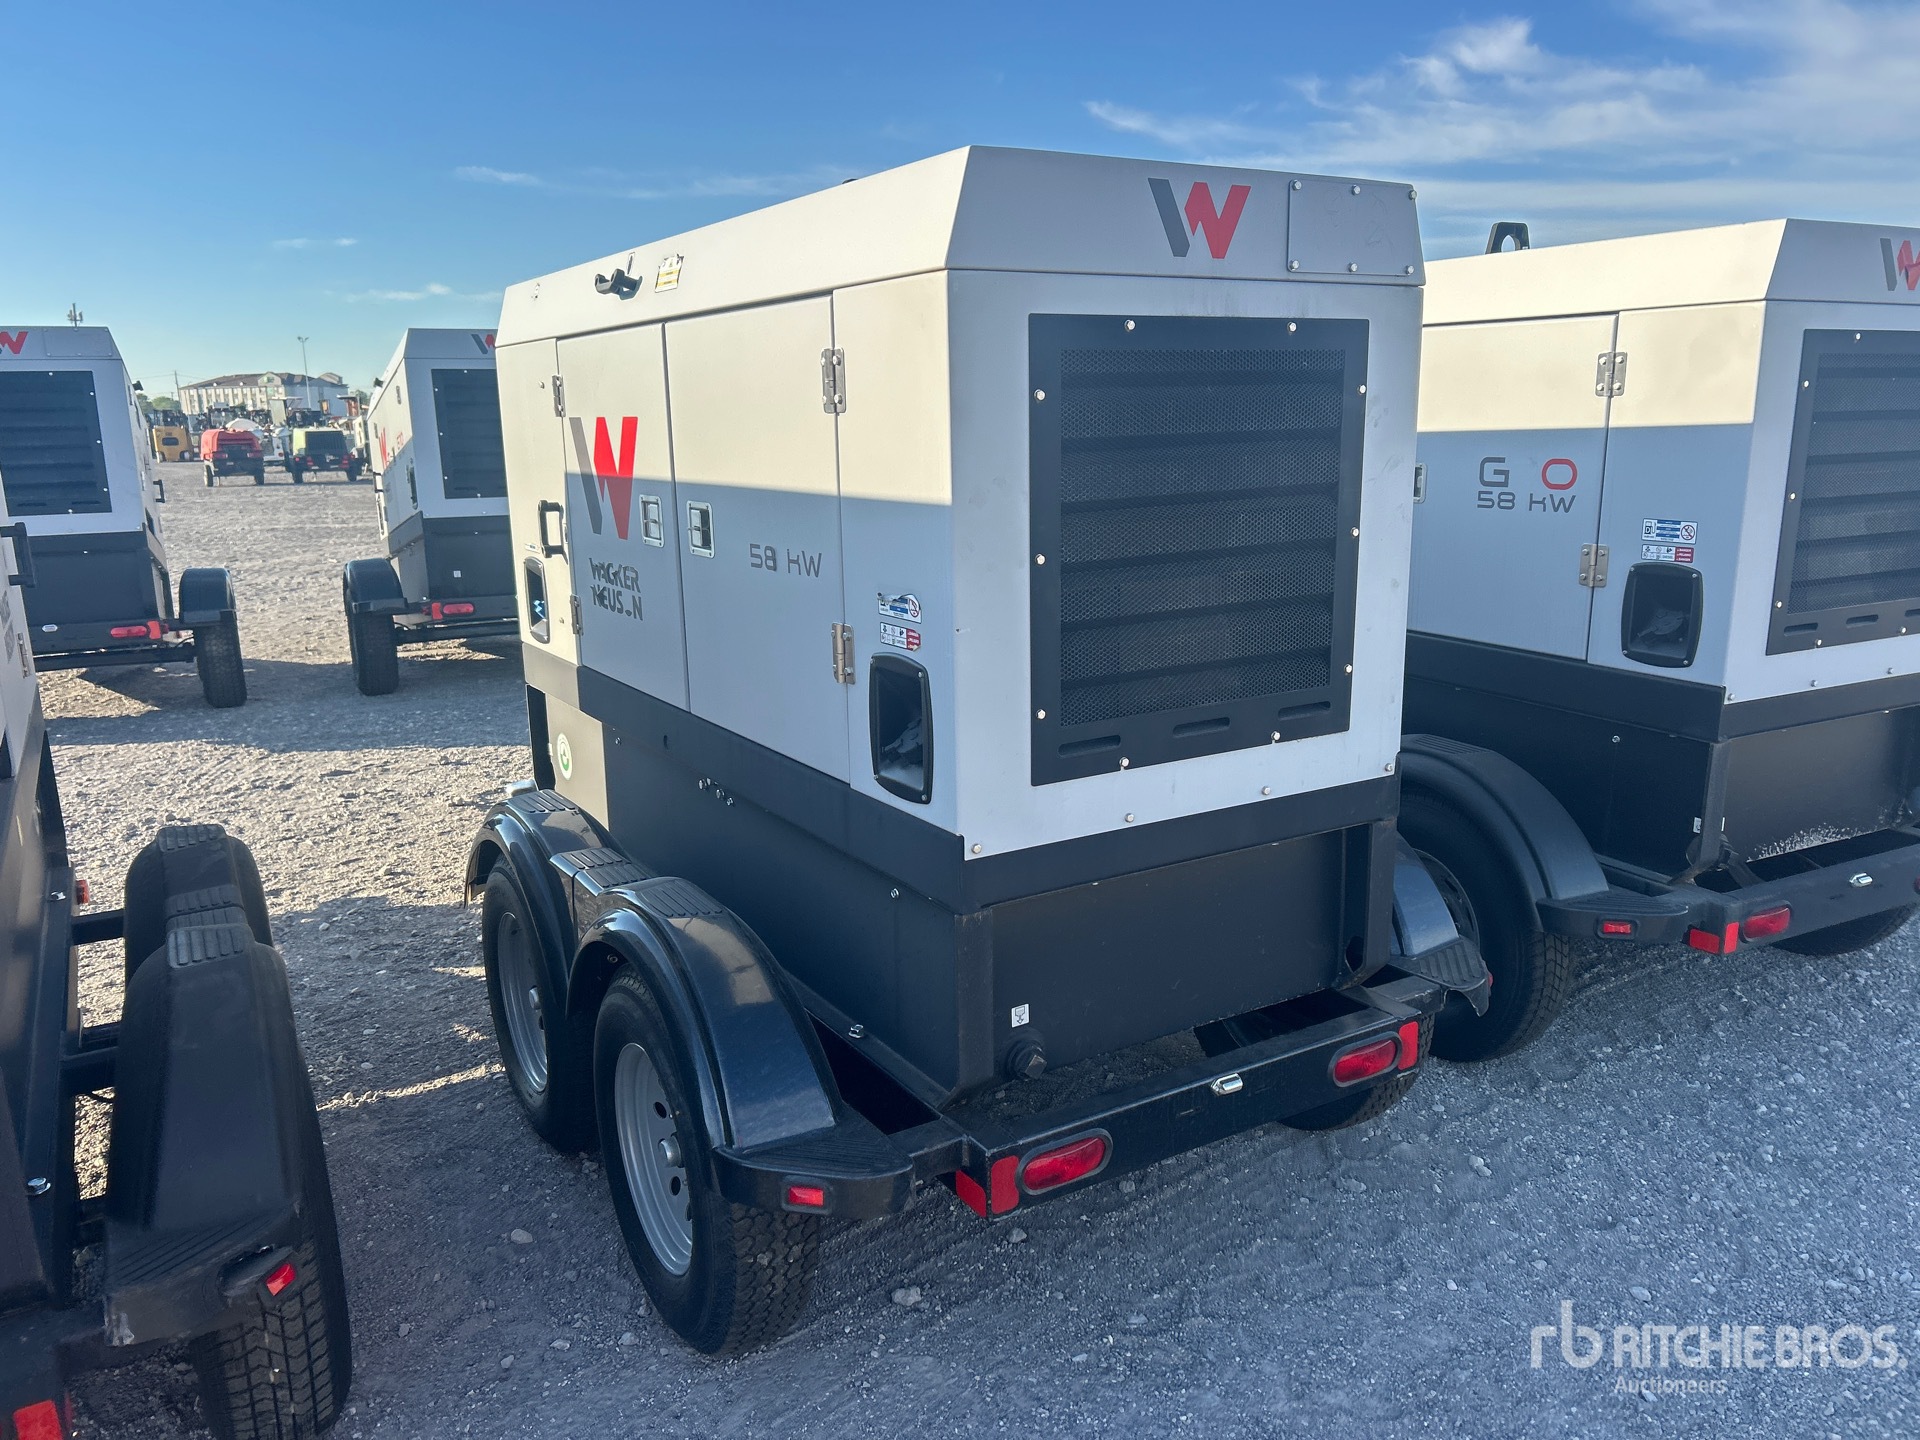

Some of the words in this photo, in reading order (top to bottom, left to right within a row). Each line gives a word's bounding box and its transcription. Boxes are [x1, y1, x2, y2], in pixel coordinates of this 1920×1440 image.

[1476, 490, 1516, 511] 58
[749, 543, 778, 572] 58
[589, 584, 644, 622] NEUSN
